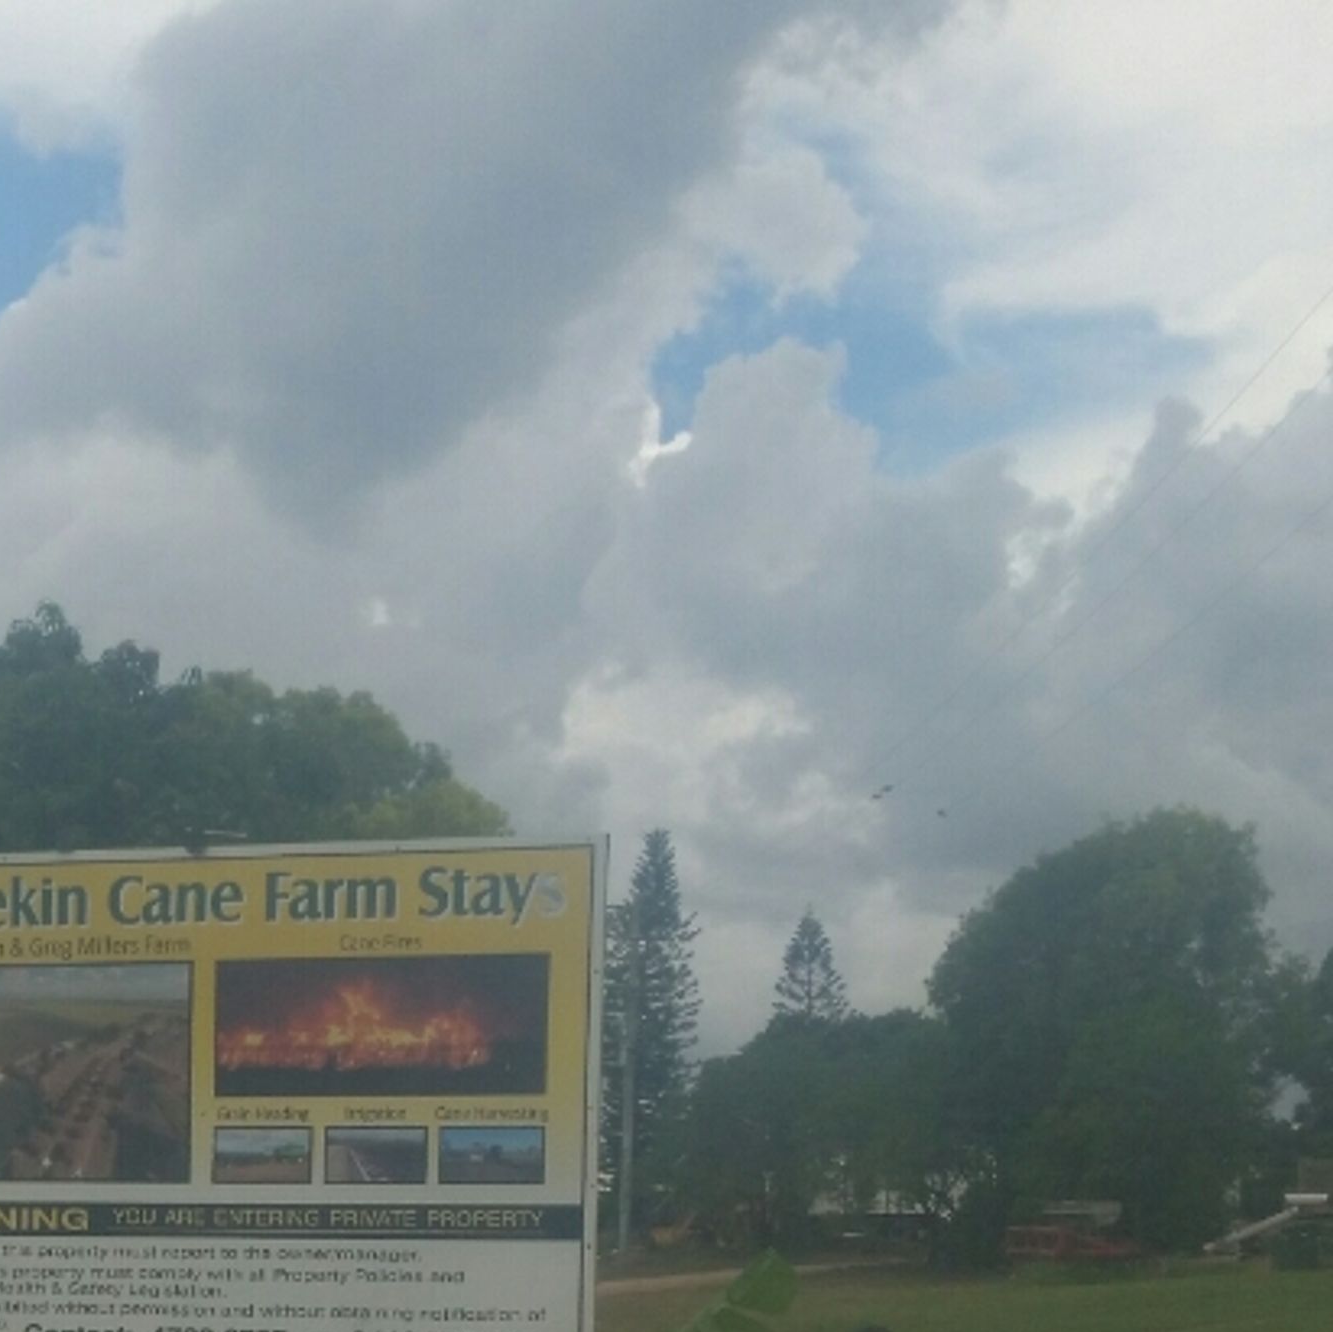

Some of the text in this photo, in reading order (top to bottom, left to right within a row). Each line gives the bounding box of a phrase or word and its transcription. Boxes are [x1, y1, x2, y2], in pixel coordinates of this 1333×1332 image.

[107, 874, 245, 926] Cane
[264, 871, 398, 922] Farm
[417, 865, 566, 927] Stays
[9, 937, 23, 957] &
[29, 936, 72, 961] Greg
[145, 933, 193, 955] Farm
[112, 1207, 543, 1228] YOU ARE ENTERING PRIVATE PROPERTY
[38, 1245, 109, 1263] property
[112, 1246, 157, 1259] must
[161, 1247, 216, 1260] report
[219, 1247, 238, 1260] to
[243, 1247, 271, 1260] the
[12, 1267, 85, 1282] property
[90, 1267, 135, 1280] must
[138, 1267, 202, 1283] comply
[273, 1268, 352, 1287] Property
[355, 1268, 424, 1284] Policies
[429, 1269, 466, 1284] and
[51, 1281, 64, 1296] &
[52, 1302, 117, 1316] without
[120, 1304, 217, 1319] permission
[220, 1304, 255, 1319] and
[259, 1304, 326, 1319] without
[527, 1307, 547, 1323] of
